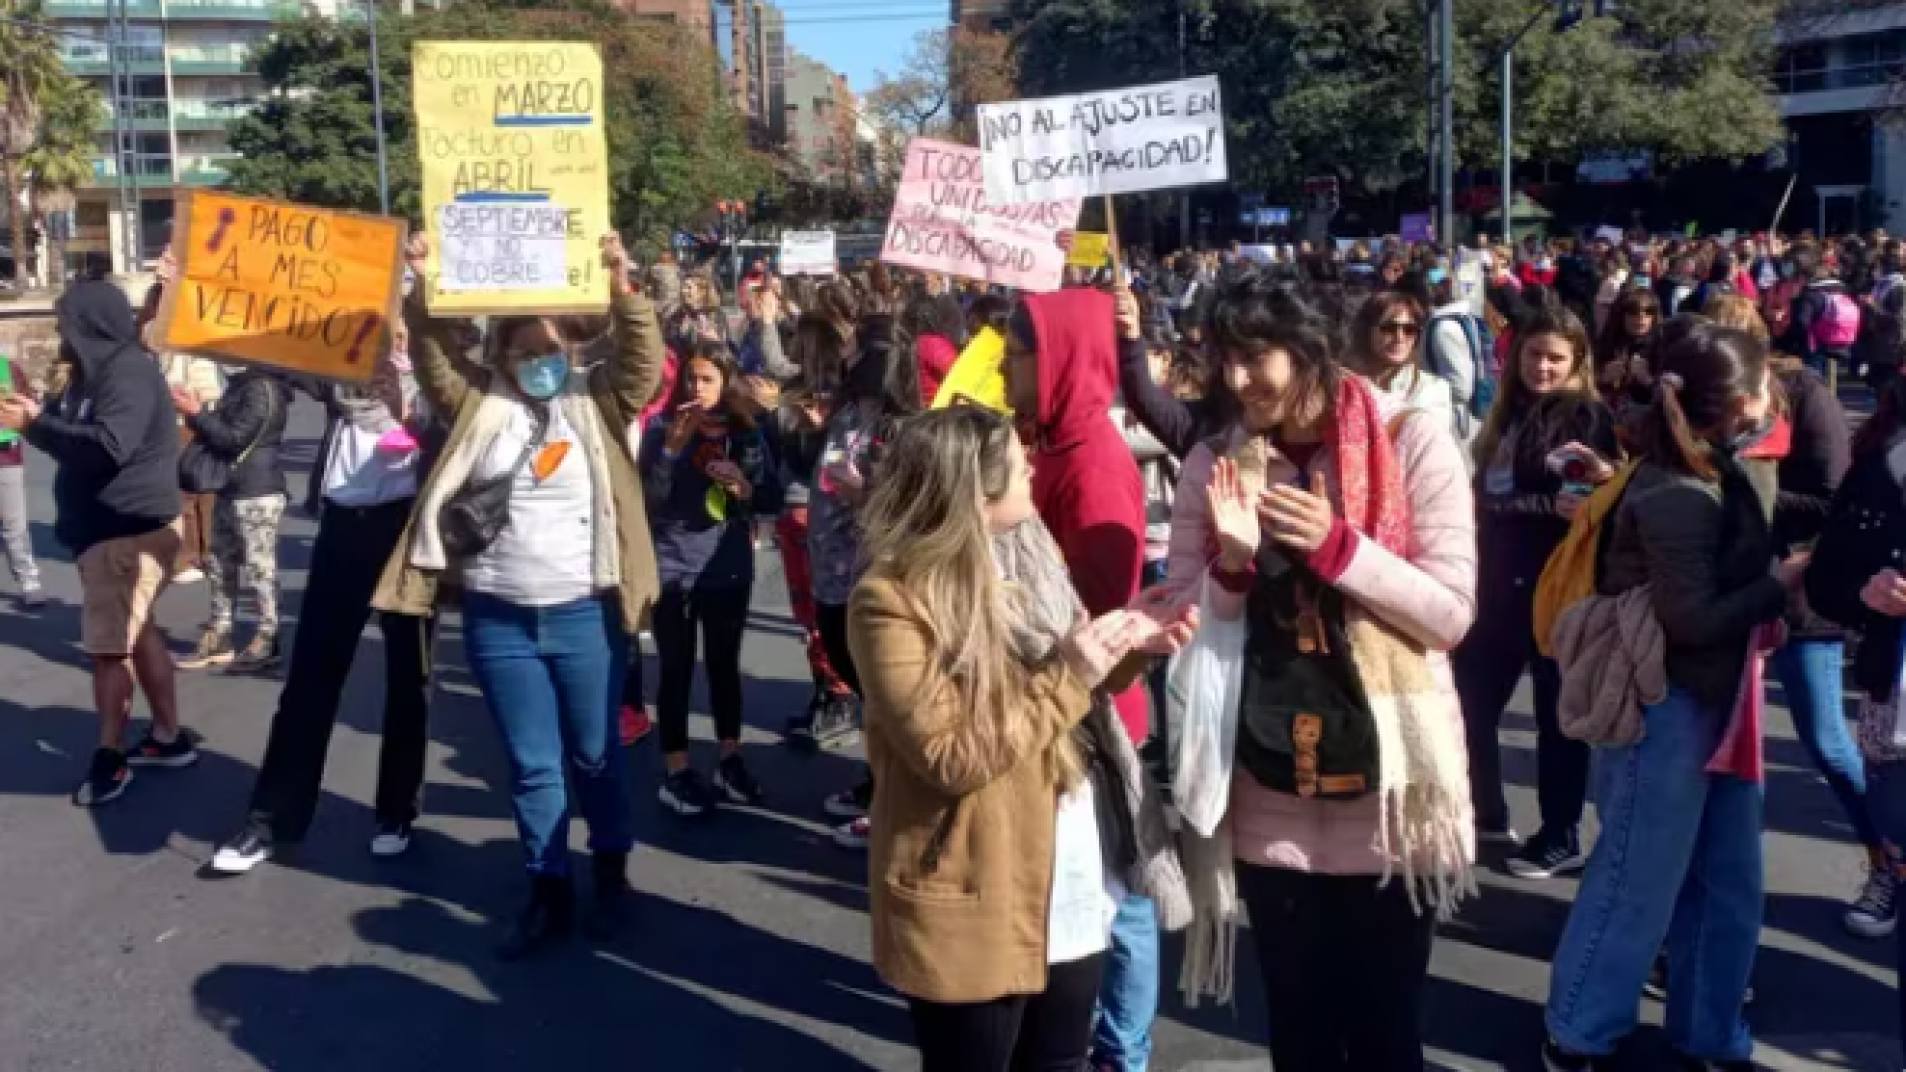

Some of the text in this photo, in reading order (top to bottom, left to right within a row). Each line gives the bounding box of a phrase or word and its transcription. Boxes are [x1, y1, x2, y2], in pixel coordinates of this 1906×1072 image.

[493, 77, 594, 119] MARZO
[1032, 108, 1065, 135] AL
[1070, 90, 1176, 137] AJUSTE
[1185, 89, 1216, 117] EN
[551, 130, 585, 154] en
[1012, 126, 1217, 186] DISCAPACIDAD!
[217, 243, 341, 299] A MES
